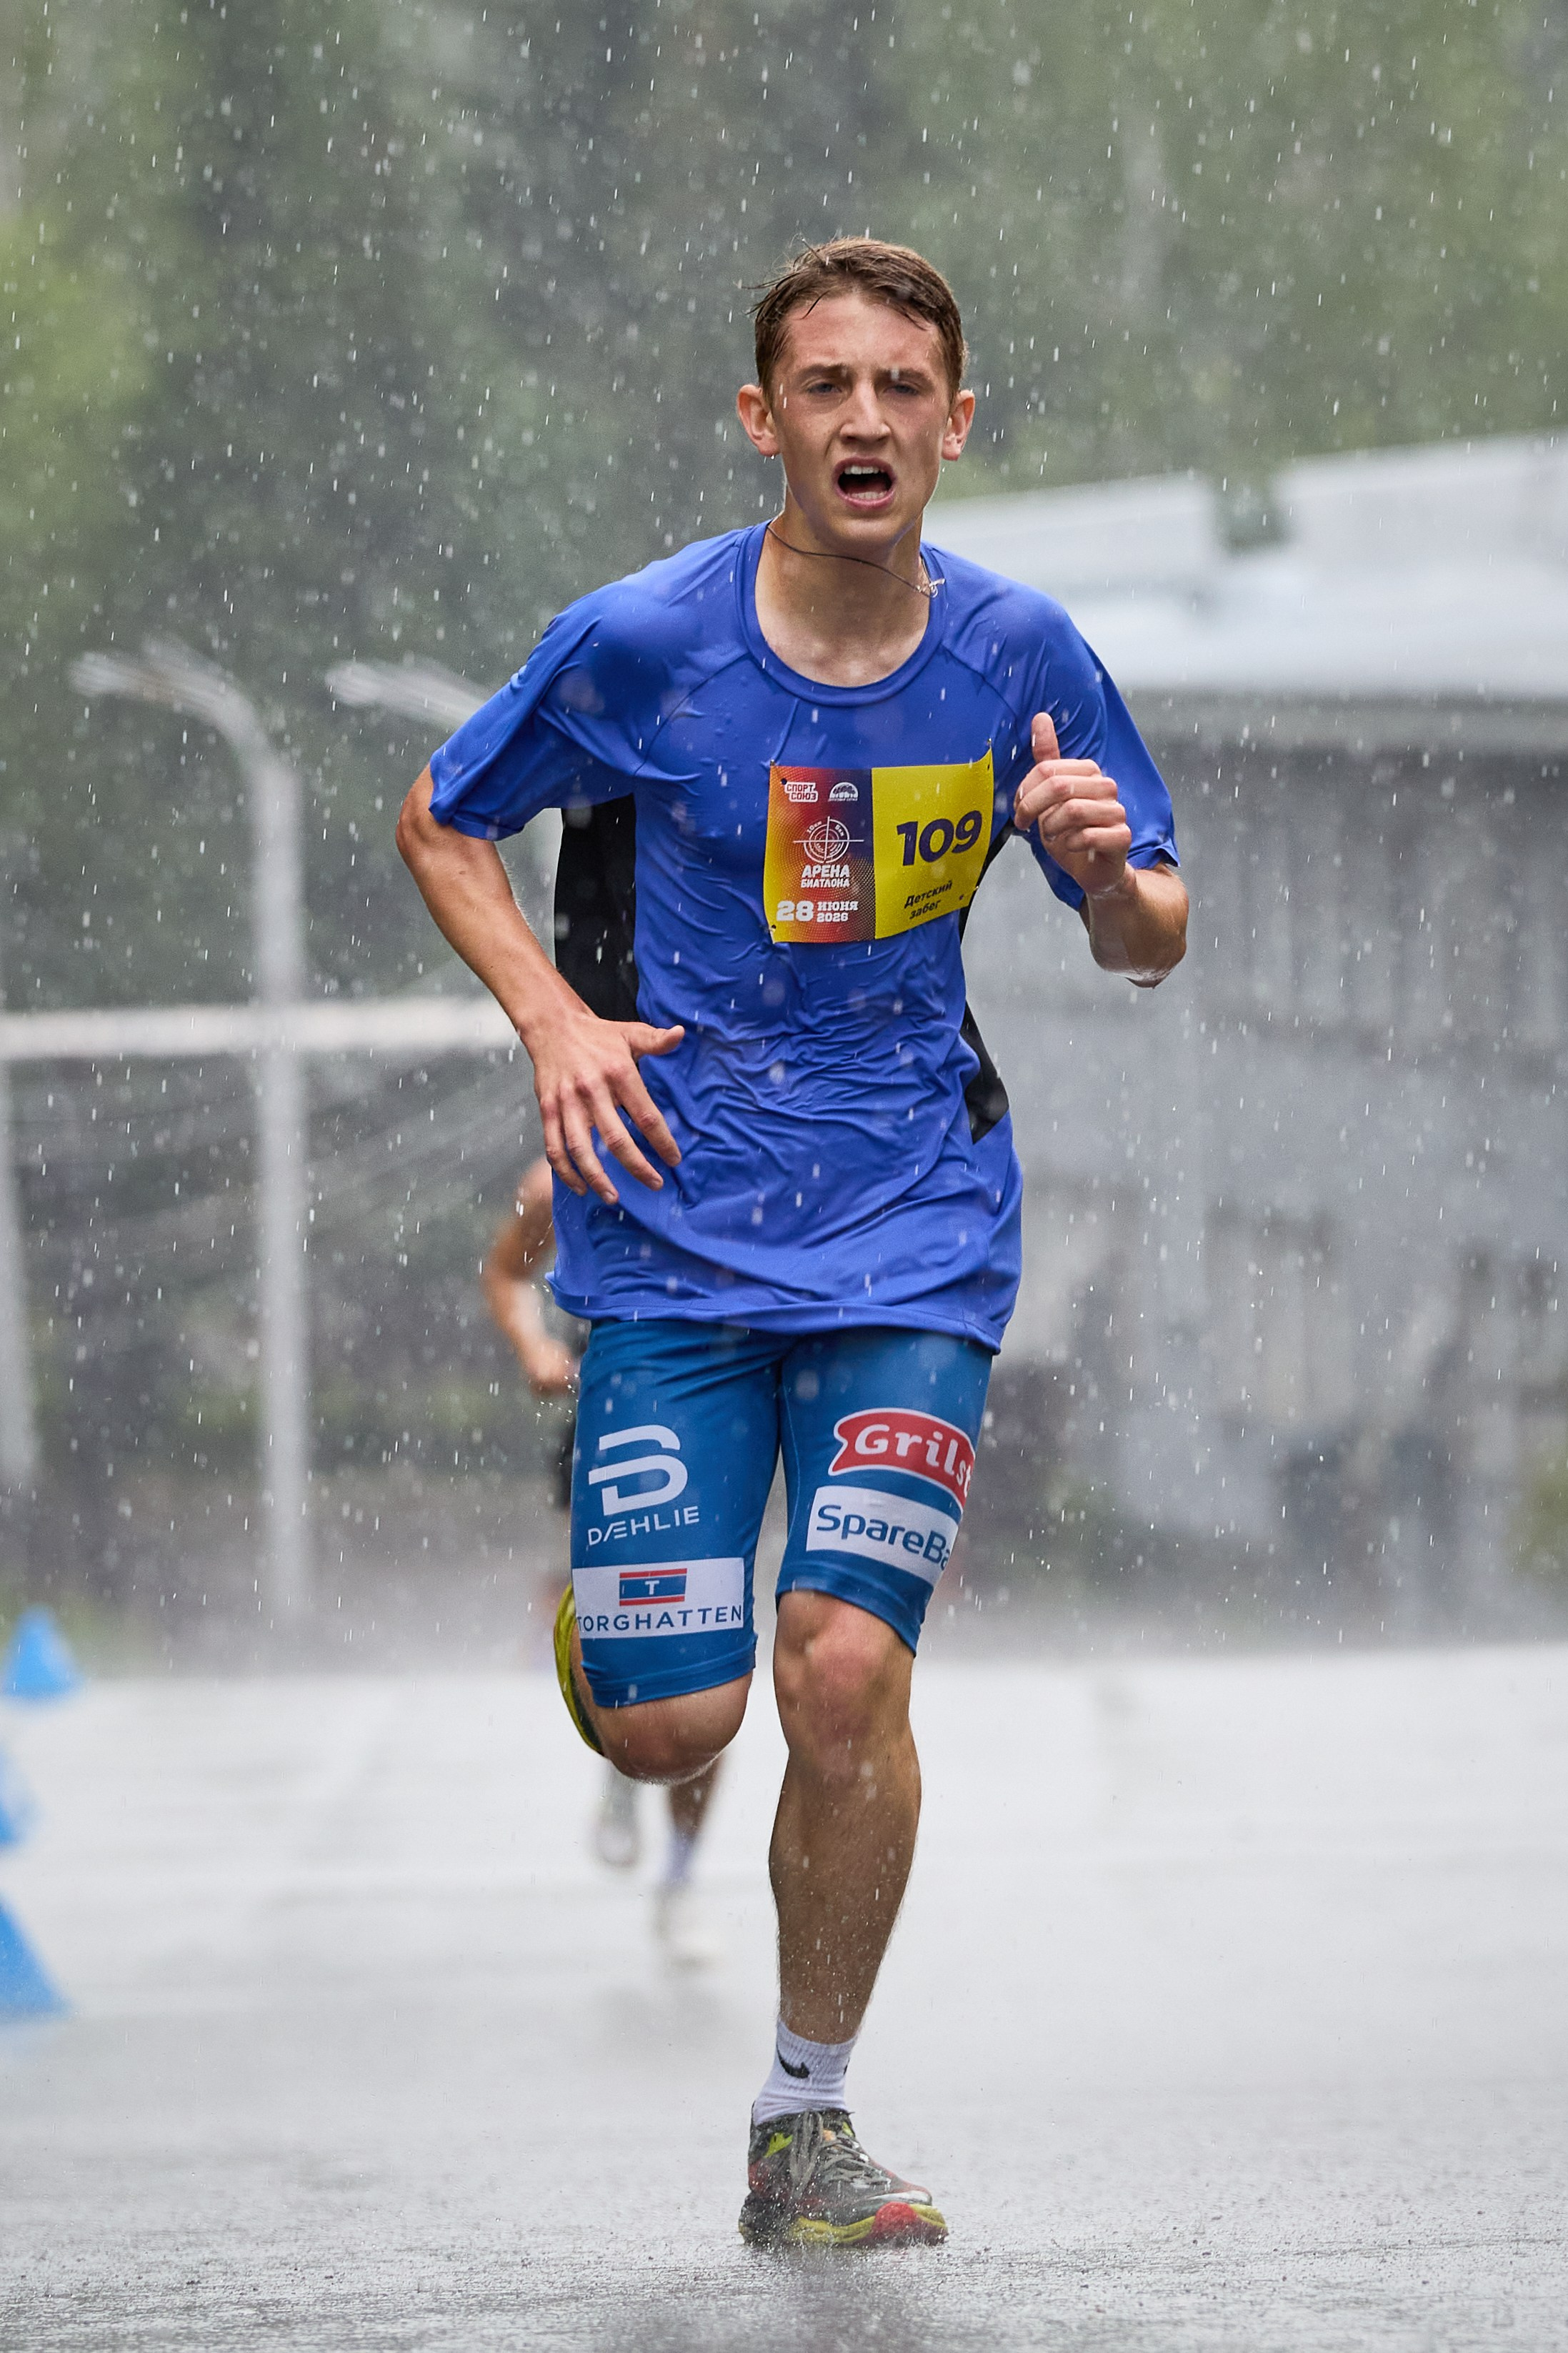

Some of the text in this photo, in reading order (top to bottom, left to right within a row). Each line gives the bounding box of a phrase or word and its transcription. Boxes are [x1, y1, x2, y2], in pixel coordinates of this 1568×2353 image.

[791, 792, 817, 800] СОЮЗ
[896, 810, 982, 866] 109
[802, 864, 850, 877] АРЕНА
[800, 878, 850, 888] БИАТЛОНА
[904, 880, 953, 909] Детский
[776, 900, 814, 921] 28
[817, 912, 849, 922] 2026
[909, 900, 942, 920] забег
[587, 1506, 699, 1546] DÆHLIE
[644, 1580, 660, 1595] T
